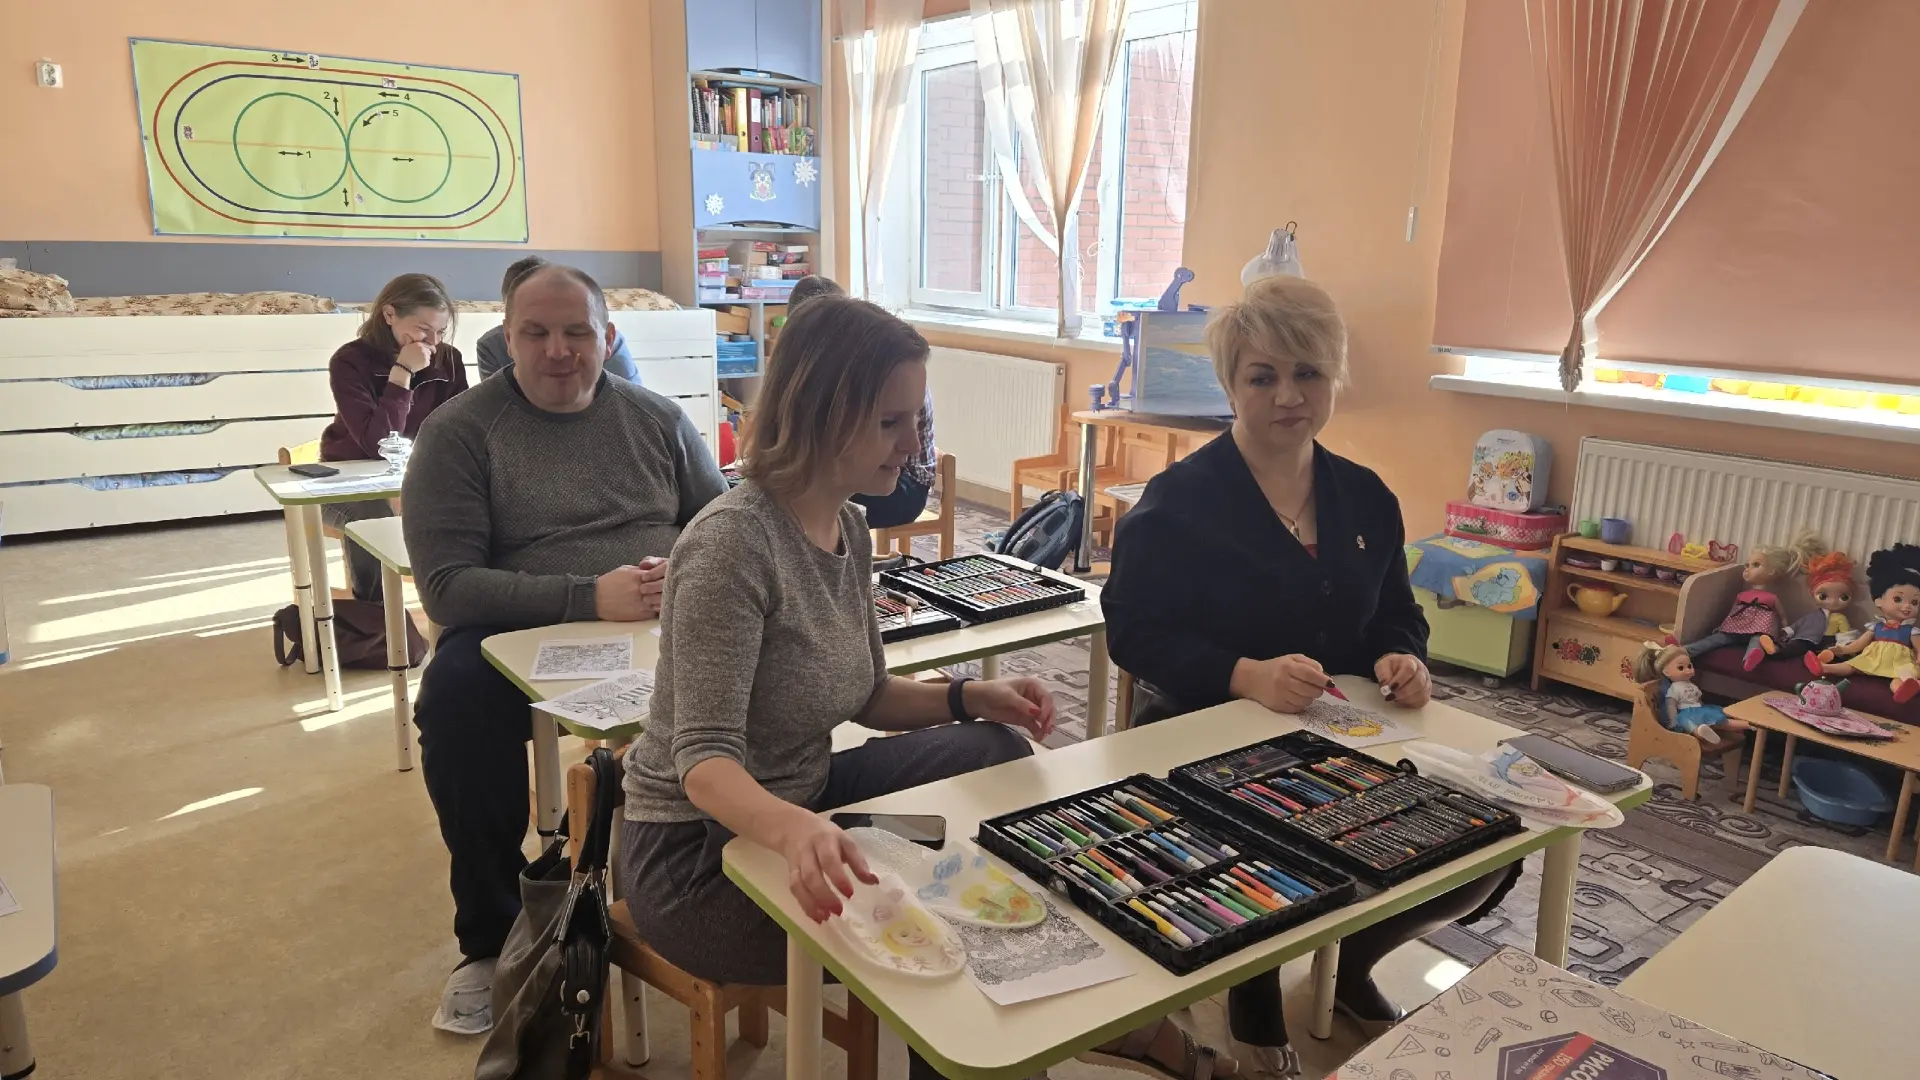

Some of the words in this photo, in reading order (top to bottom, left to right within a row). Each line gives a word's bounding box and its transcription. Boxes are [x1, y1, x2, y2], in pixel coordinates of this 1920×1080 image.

[271, 54, 279, 62] 3
[323, 91, 331, 100] 2
[404, 93, 411, 101] 4
[392, 109, 399, 117] 5
[306, 150, 312, 159] 1
[1564, 1051, 1615, 1080] РИСО
